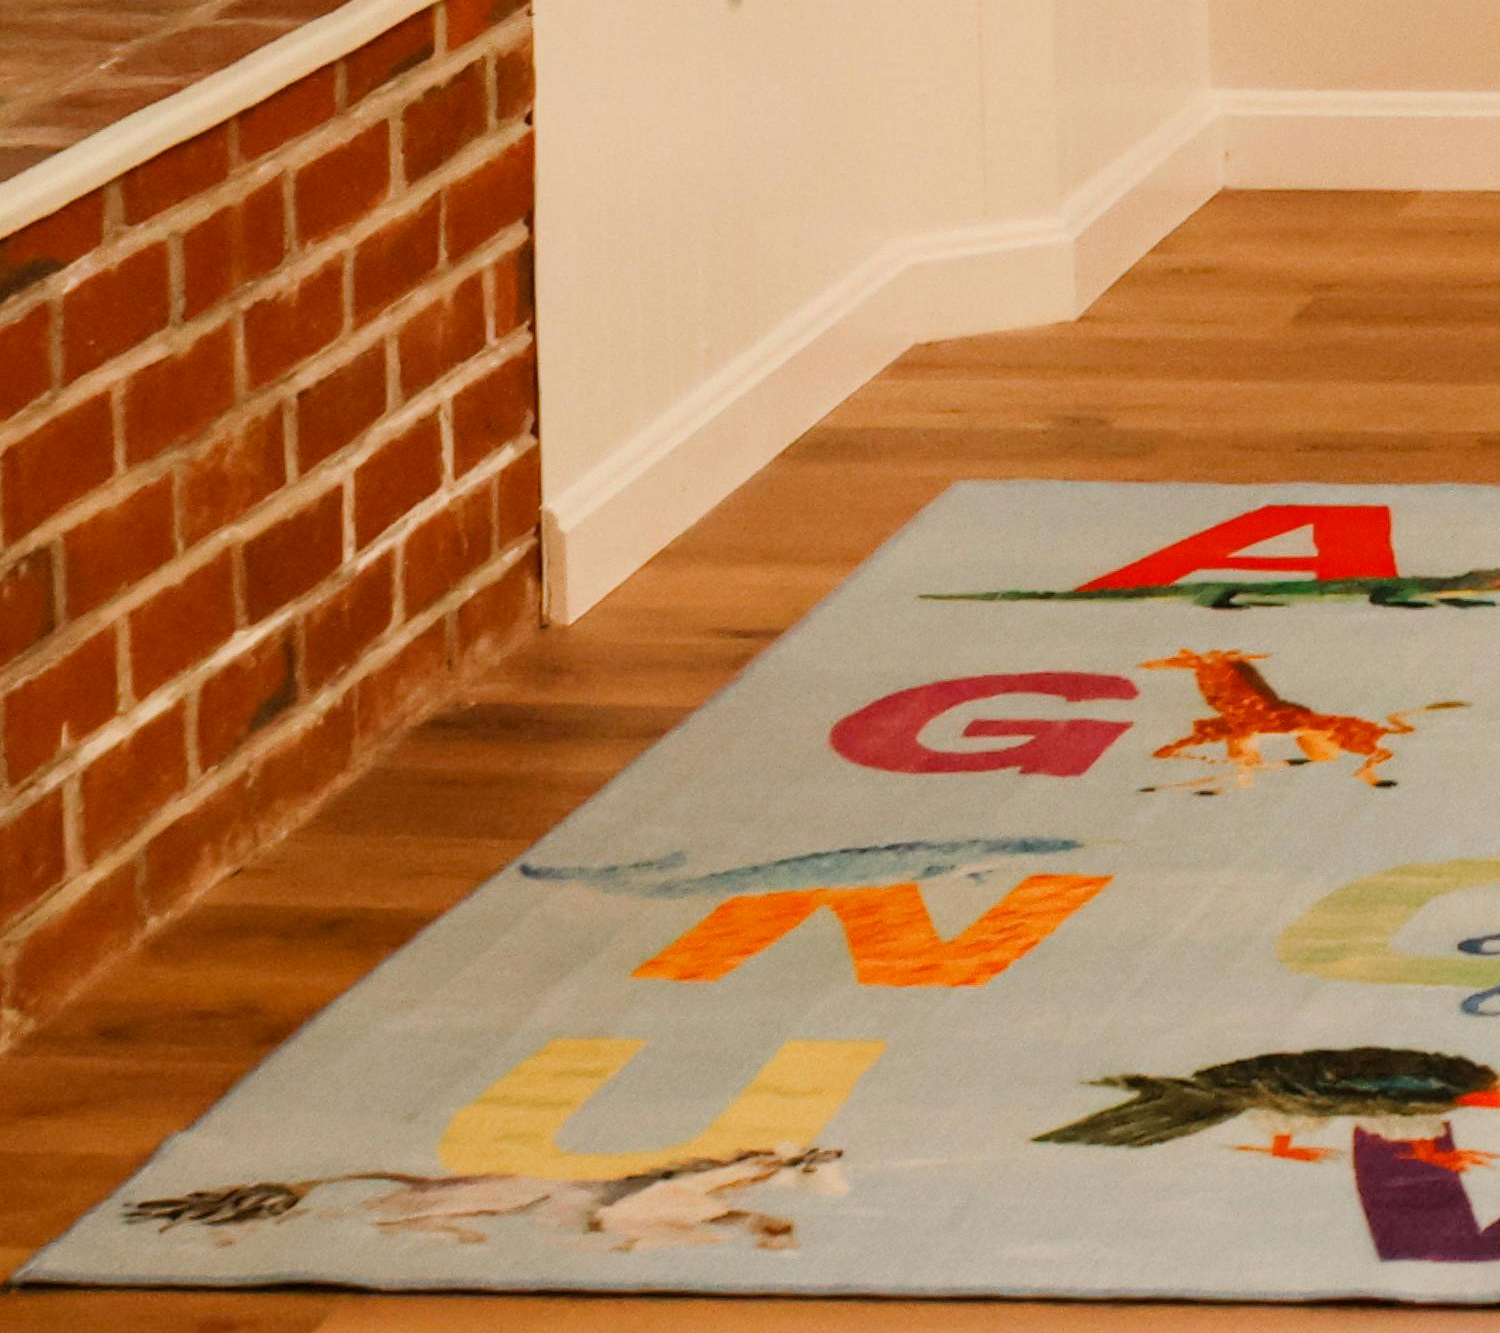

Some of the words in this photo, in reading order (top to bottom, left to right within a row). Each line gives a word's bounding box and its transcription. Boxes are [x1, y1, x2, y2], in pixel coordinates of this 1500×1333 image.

[1074, 502, 1402, 593] A
[827, 670, 1141, 778] G
[629, 873, 1114, 987] N
[437, 1039, 886, 1182] U
